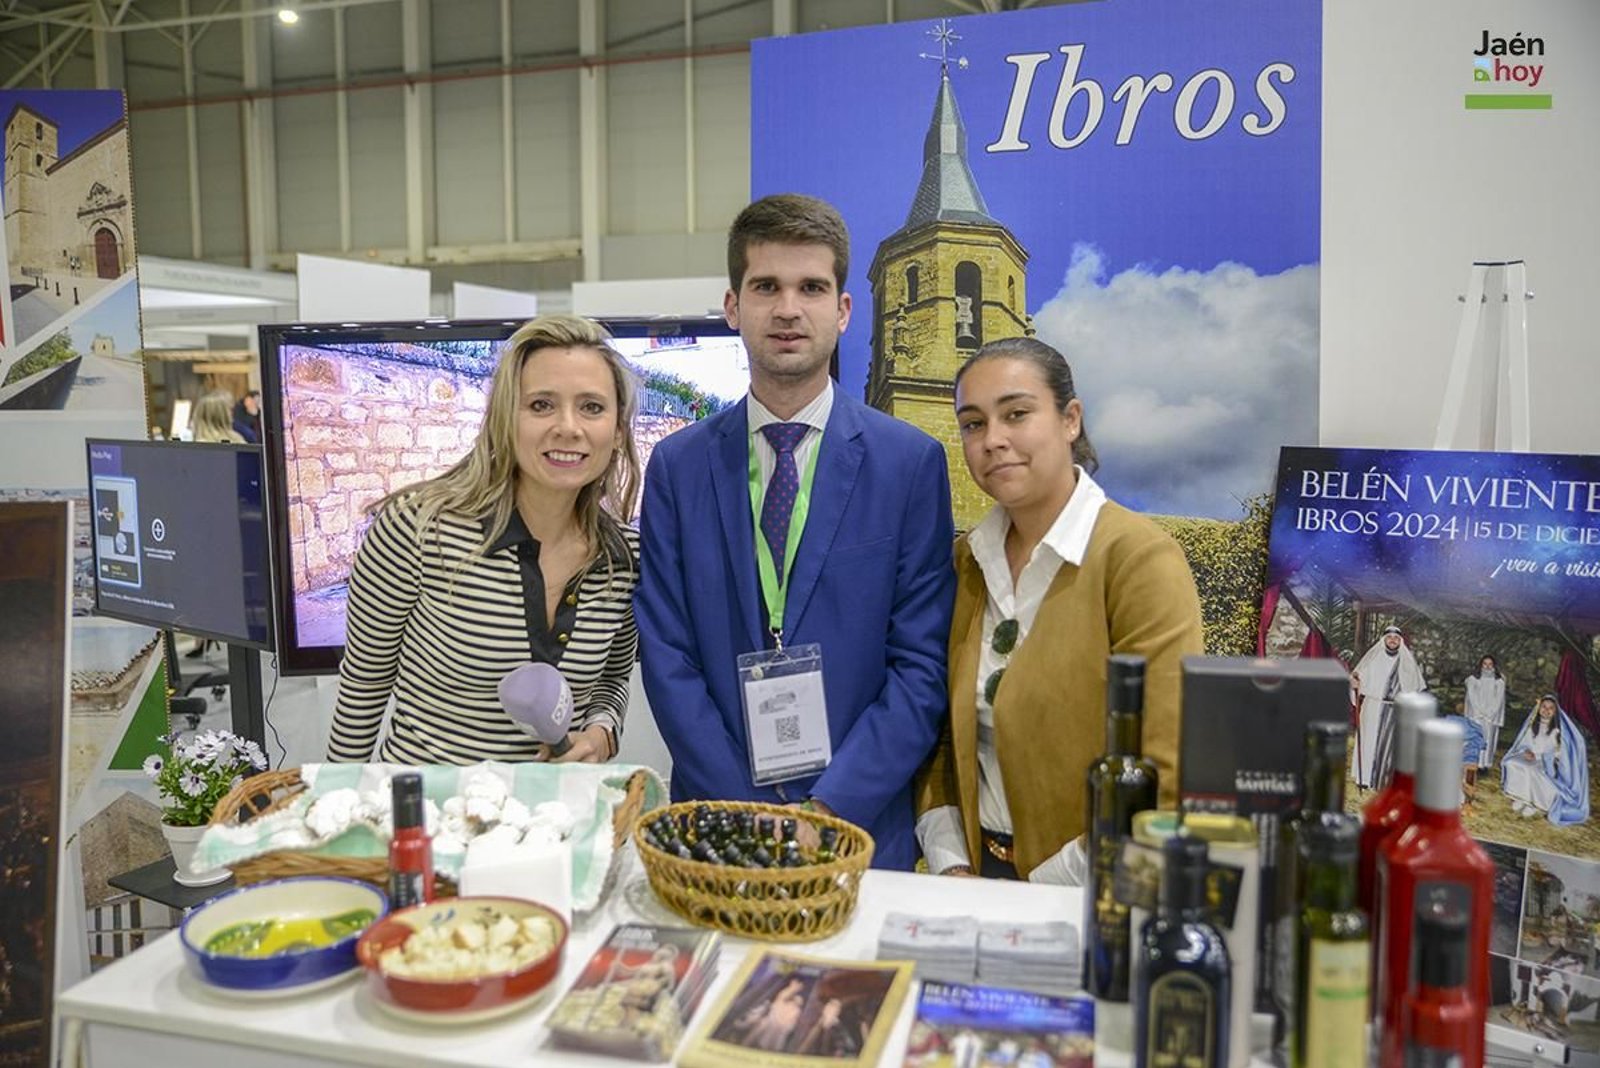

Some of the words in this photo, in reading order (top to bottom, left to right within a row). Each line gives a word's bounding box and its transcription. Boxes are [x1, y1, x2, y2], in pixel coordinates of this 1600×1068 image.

[985, 43, 1296, 154] Ibros
[1300, 467, 1411, 503] BELÉN
[1423, 475, 1600, 513] VIVIENTE
[1296, 508, 1379, 535] IBROS
[1386, 512, 1459, 541] 2024
[1474, 521, 1492, 538] 15
[1499, 522, 1529, 541] DE
[1544, 562, 1559, 576] a
